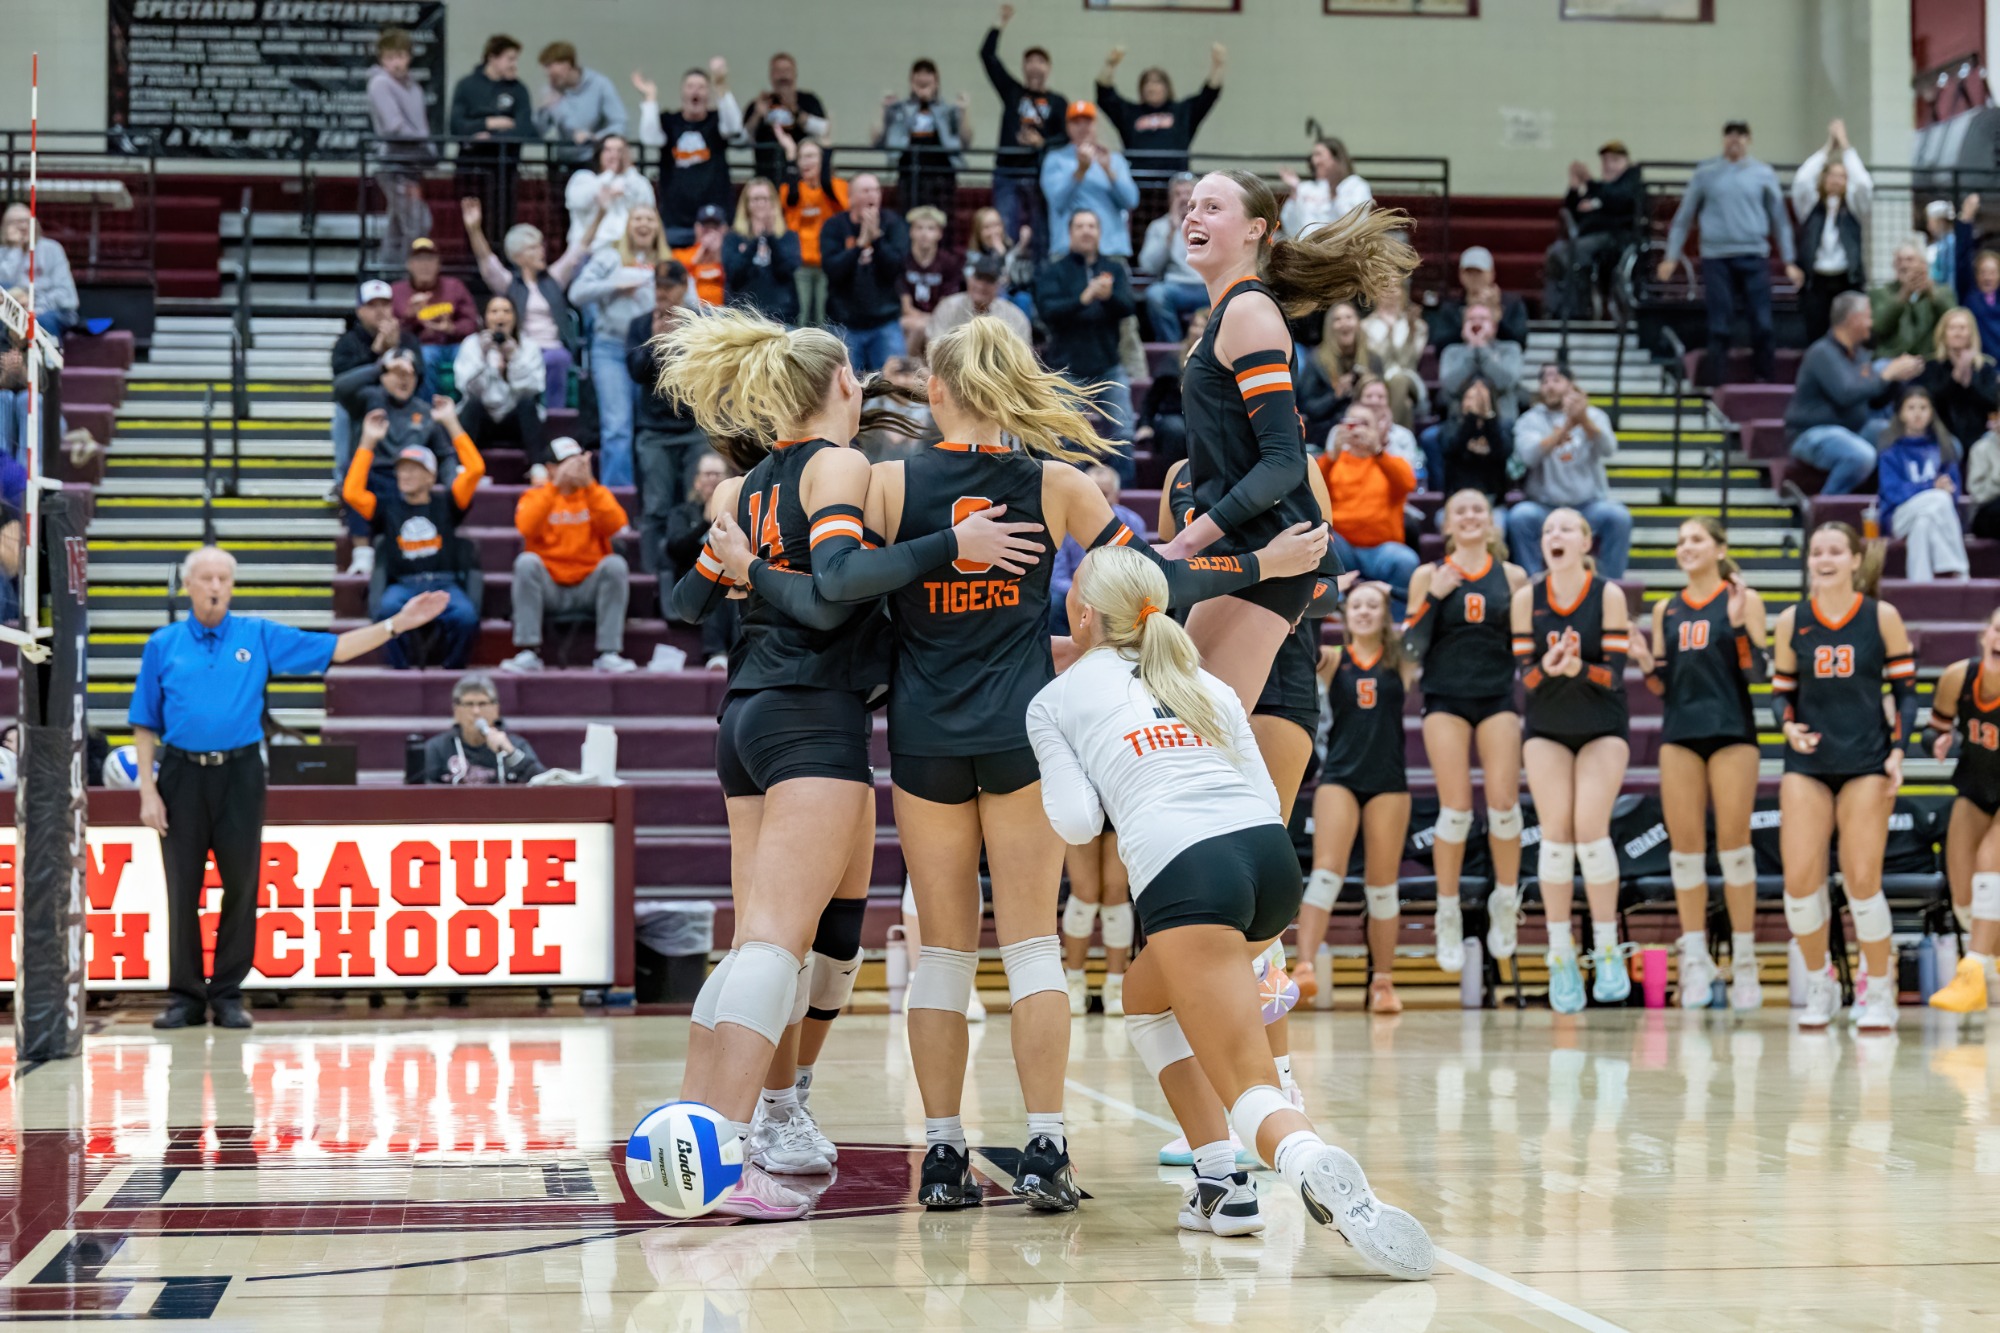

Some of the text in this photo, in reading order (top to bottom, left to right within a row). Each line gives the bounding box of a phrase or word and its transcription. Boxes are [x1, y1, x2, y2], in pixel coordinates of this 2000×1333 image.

[749, 484, 785, 557] 14
[1185, 555, 1243, 573] TIGERS
[923, 577, 1021, 613] TIGERS
[1464, 592, 1485, 623] 8
[1678, 620, 1710, 652] 10
[1814, 644, 1855, 678] 23
[1356, 677, 1377, 709] 5
[1123, 724, 1212, 757] TIGE
[198, 838, 576, 908] RAGUE
[198, 909, 562, 978] CHOOL
[658, 1147, 670, 1188] PERFECTION
[676, 1138, 697, 1191] Baden
